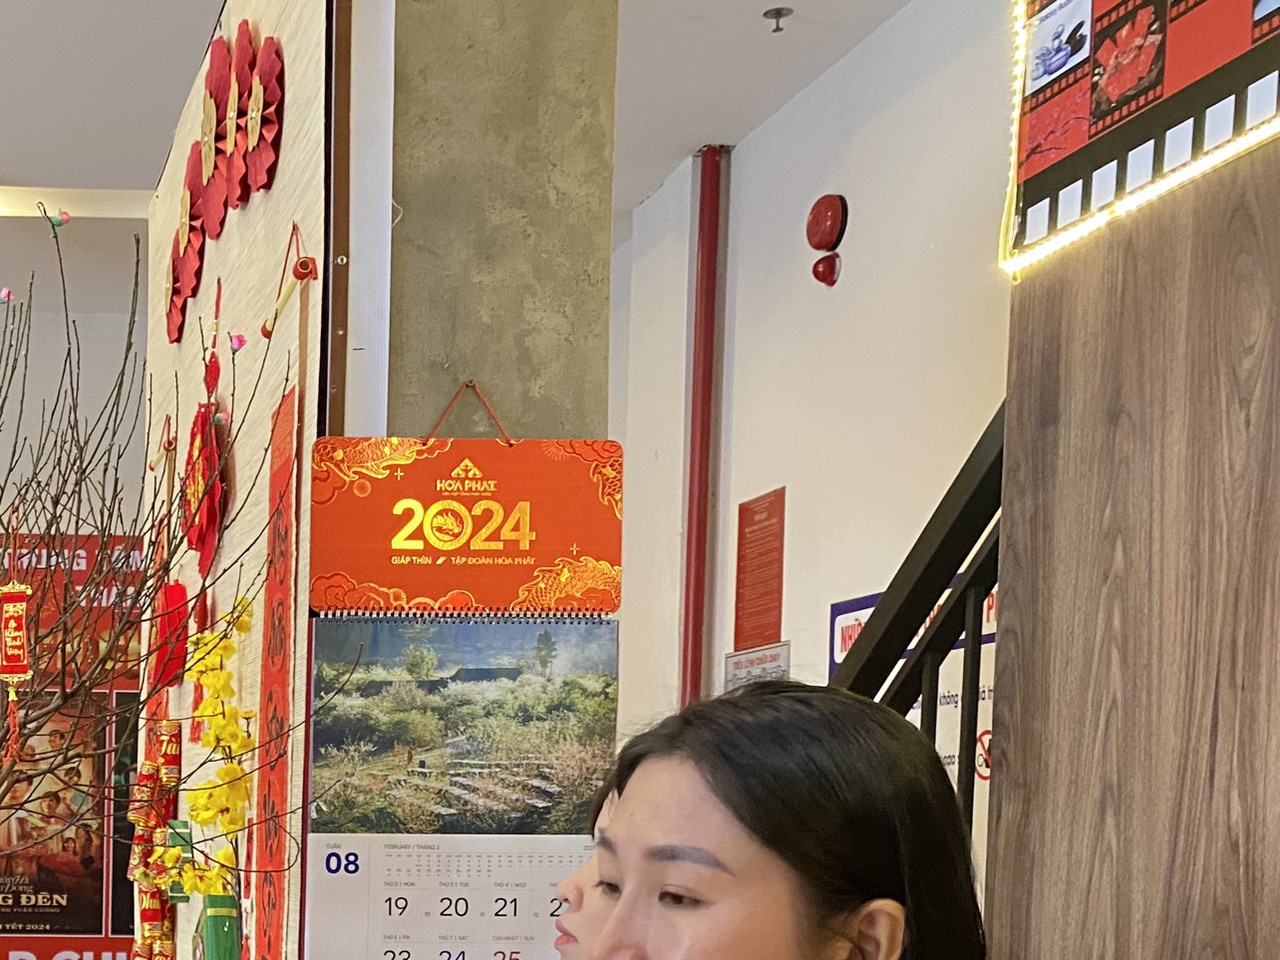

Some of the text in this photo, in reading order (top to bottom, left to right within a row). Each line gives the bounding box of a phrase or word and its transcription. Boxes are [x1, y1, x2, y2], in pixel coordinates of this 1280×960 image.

[391, 498, 536, 550] 2024
[391, 555, 410, 564] GIÁP
[451, 556, 466, 565] TẬP
[325, 852, 360, 874] 08
[384, 897, 409, 916] 19
[439, 897, 469, 917] 20
[494, 897, 518, 917] 21
[549, 898, 563, 917] 2
